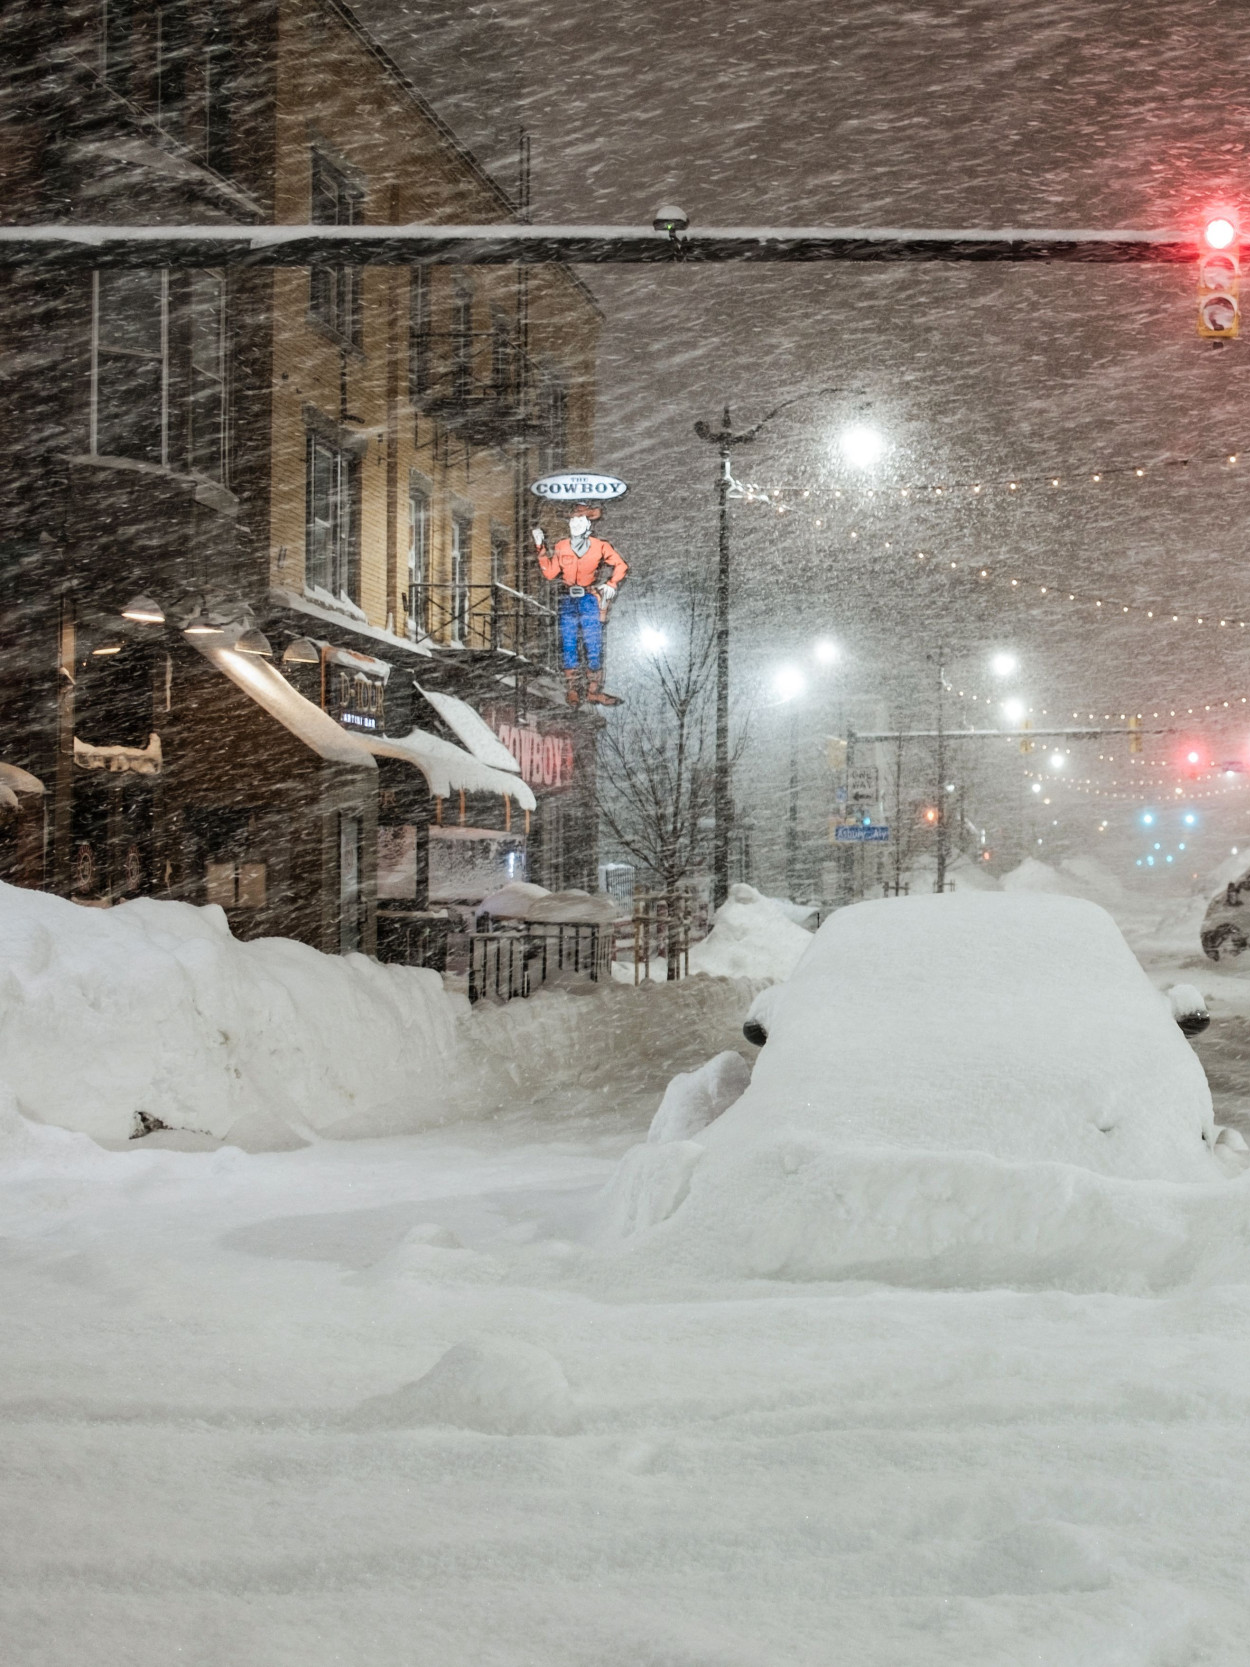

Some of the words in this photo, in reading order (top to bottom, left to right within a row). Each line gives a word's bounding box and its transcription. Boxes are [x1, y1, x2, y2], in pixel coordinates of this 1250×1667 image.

[536, 482, 621, 494] COWBOY
[341, 713, 363, 725] ARTINI
[852, 770, 872, 780] ONE
[852, 780, 871, 789] WAY
